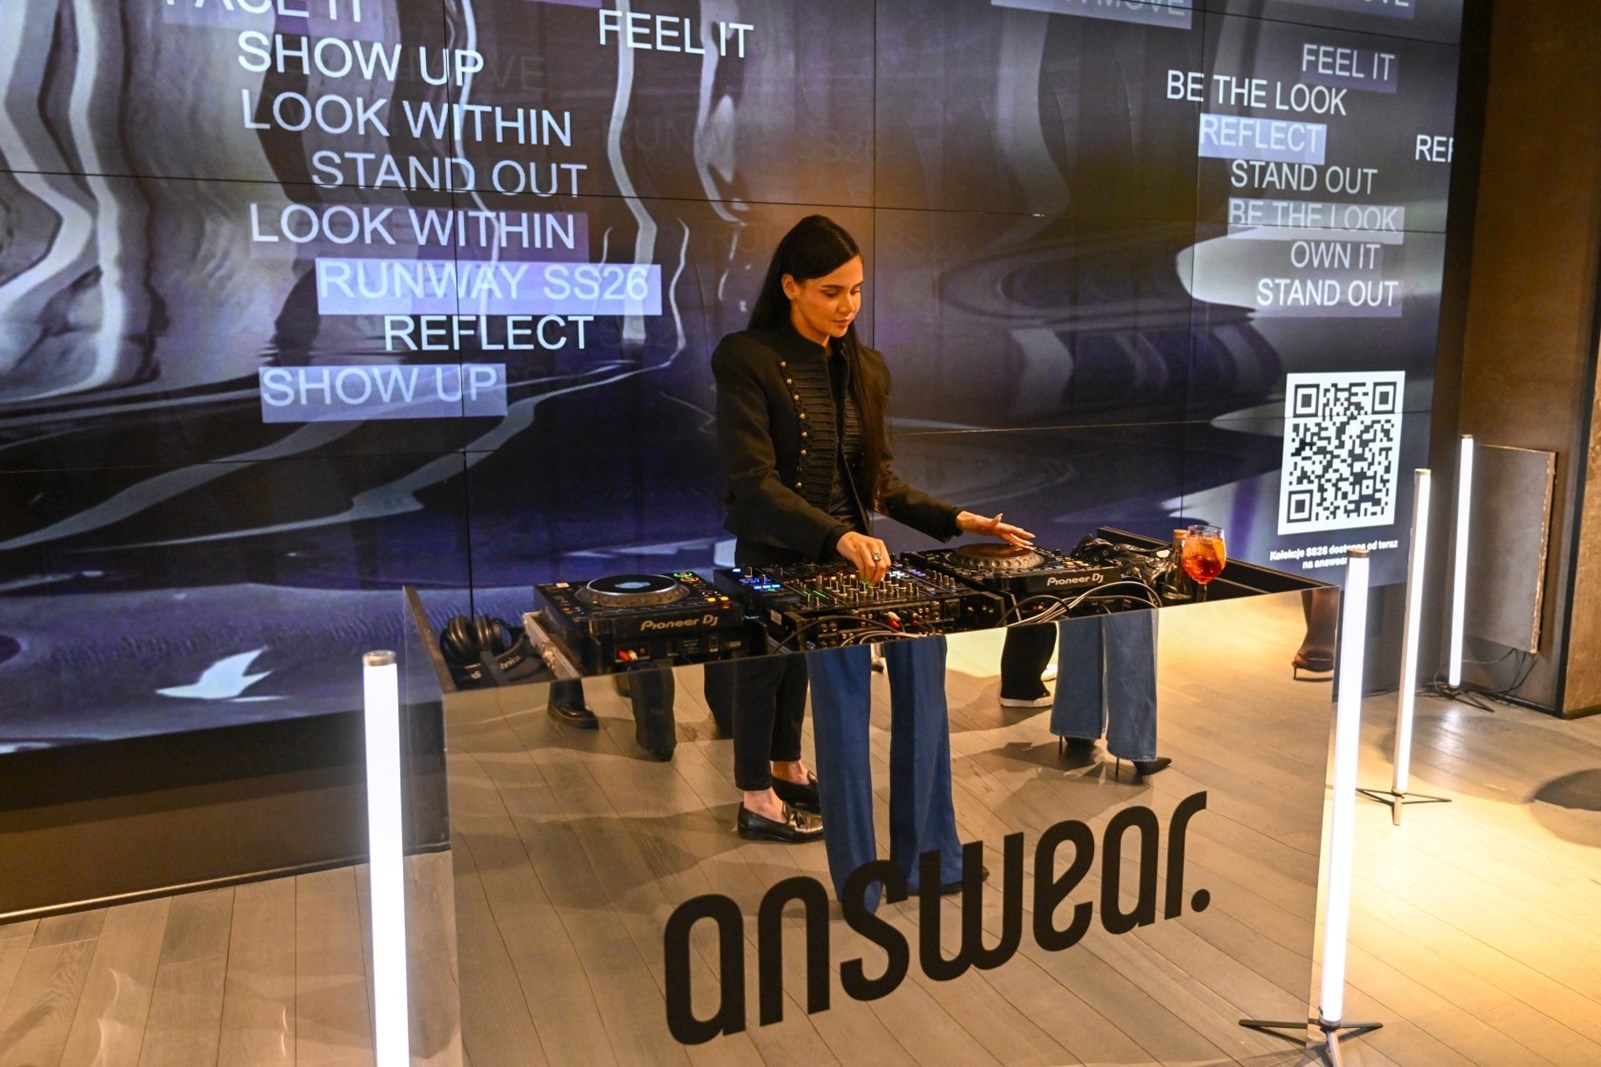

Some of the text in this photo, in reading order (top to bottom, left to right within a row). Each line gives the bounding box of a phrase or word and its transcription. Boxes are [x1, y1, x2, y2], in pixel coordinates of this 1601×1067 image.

[599, 9, 754, 58] FEEL IT
[238, 30, 402, 81] SHOW
[419, 46, 484, 86] UP
[1302, 43, 1395, 81] FEEL IT
[1167, 69, 1347, 116] BE THE LOOK
[242, 89, 391, 137] LOOK
[402, 100, 572, 147] WITHIN
[1200, 117, 1324, 152] REFLECT
[311, 150, 587, 198] STAND OUT
[1231, 159, 1378, 195] STAND OUT
[251, 203, 575, 249] LOOK WITHIN
[1229, 201, 1398, 232] BE THE LOOK
[1291, 241, 1380, 269] OWN IT
[319, 261, 649, 301] RUNWAY SS26
[1257, 278, 1398, 307] STAND OUT
[383, 315, 594, 350] REFLECT
[262, 367, 498, 406] SHOW UP
[1047, 575, 1091, 587] Pioneer
[640, 618, 699, 632] Pioneer
